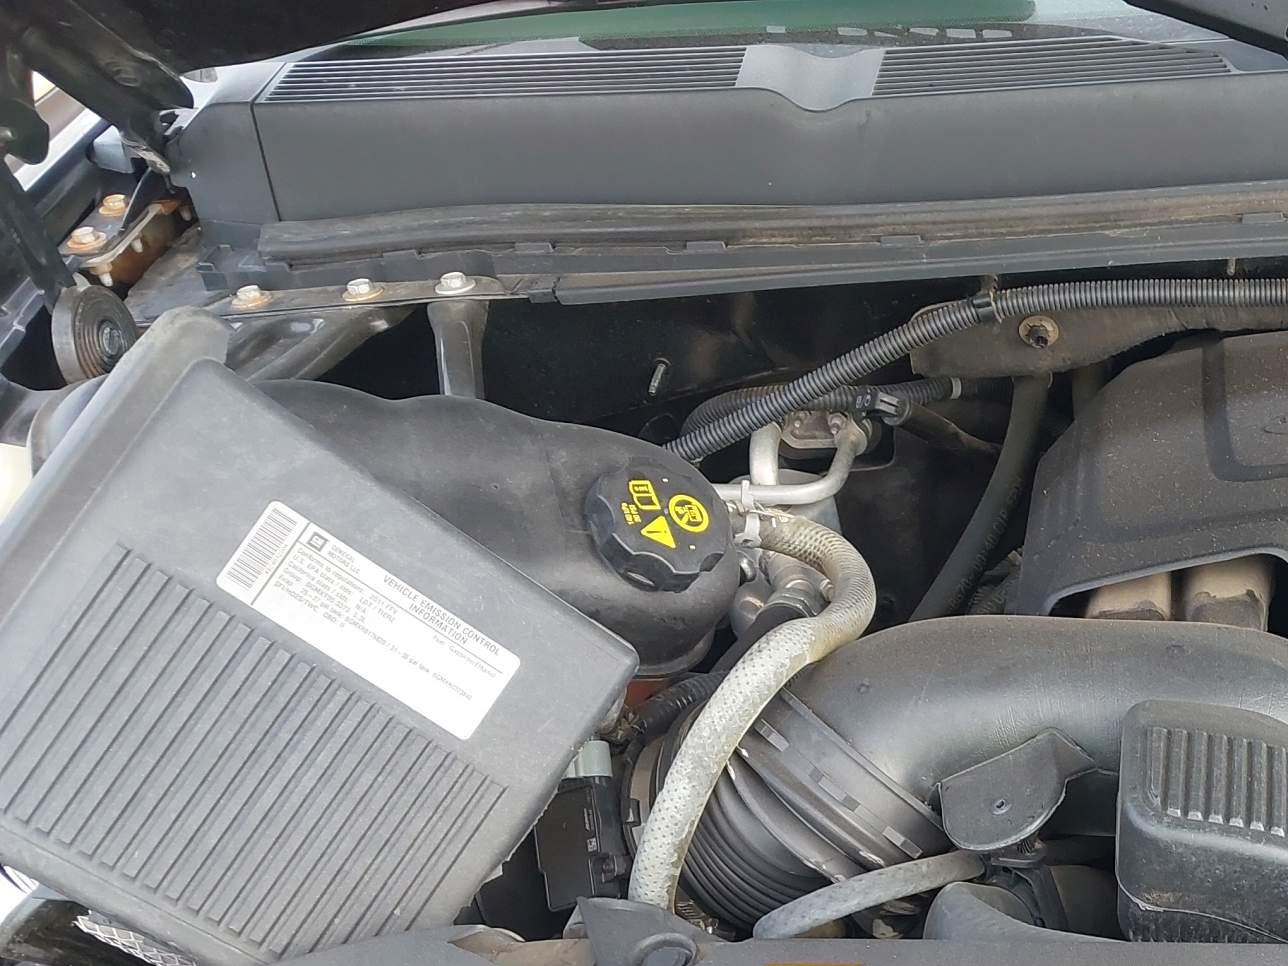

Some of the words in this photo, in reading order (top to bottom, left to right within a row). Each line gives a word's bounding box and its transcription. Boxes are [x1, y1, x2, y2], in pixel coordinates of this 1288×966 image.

[381, 574, 420, 602] VEHICLE
[418, 597, 463, 630] EMISSION
[460, 625, 502, 656] CONTROL
[407, 602, 469, 645] INFORMATION
